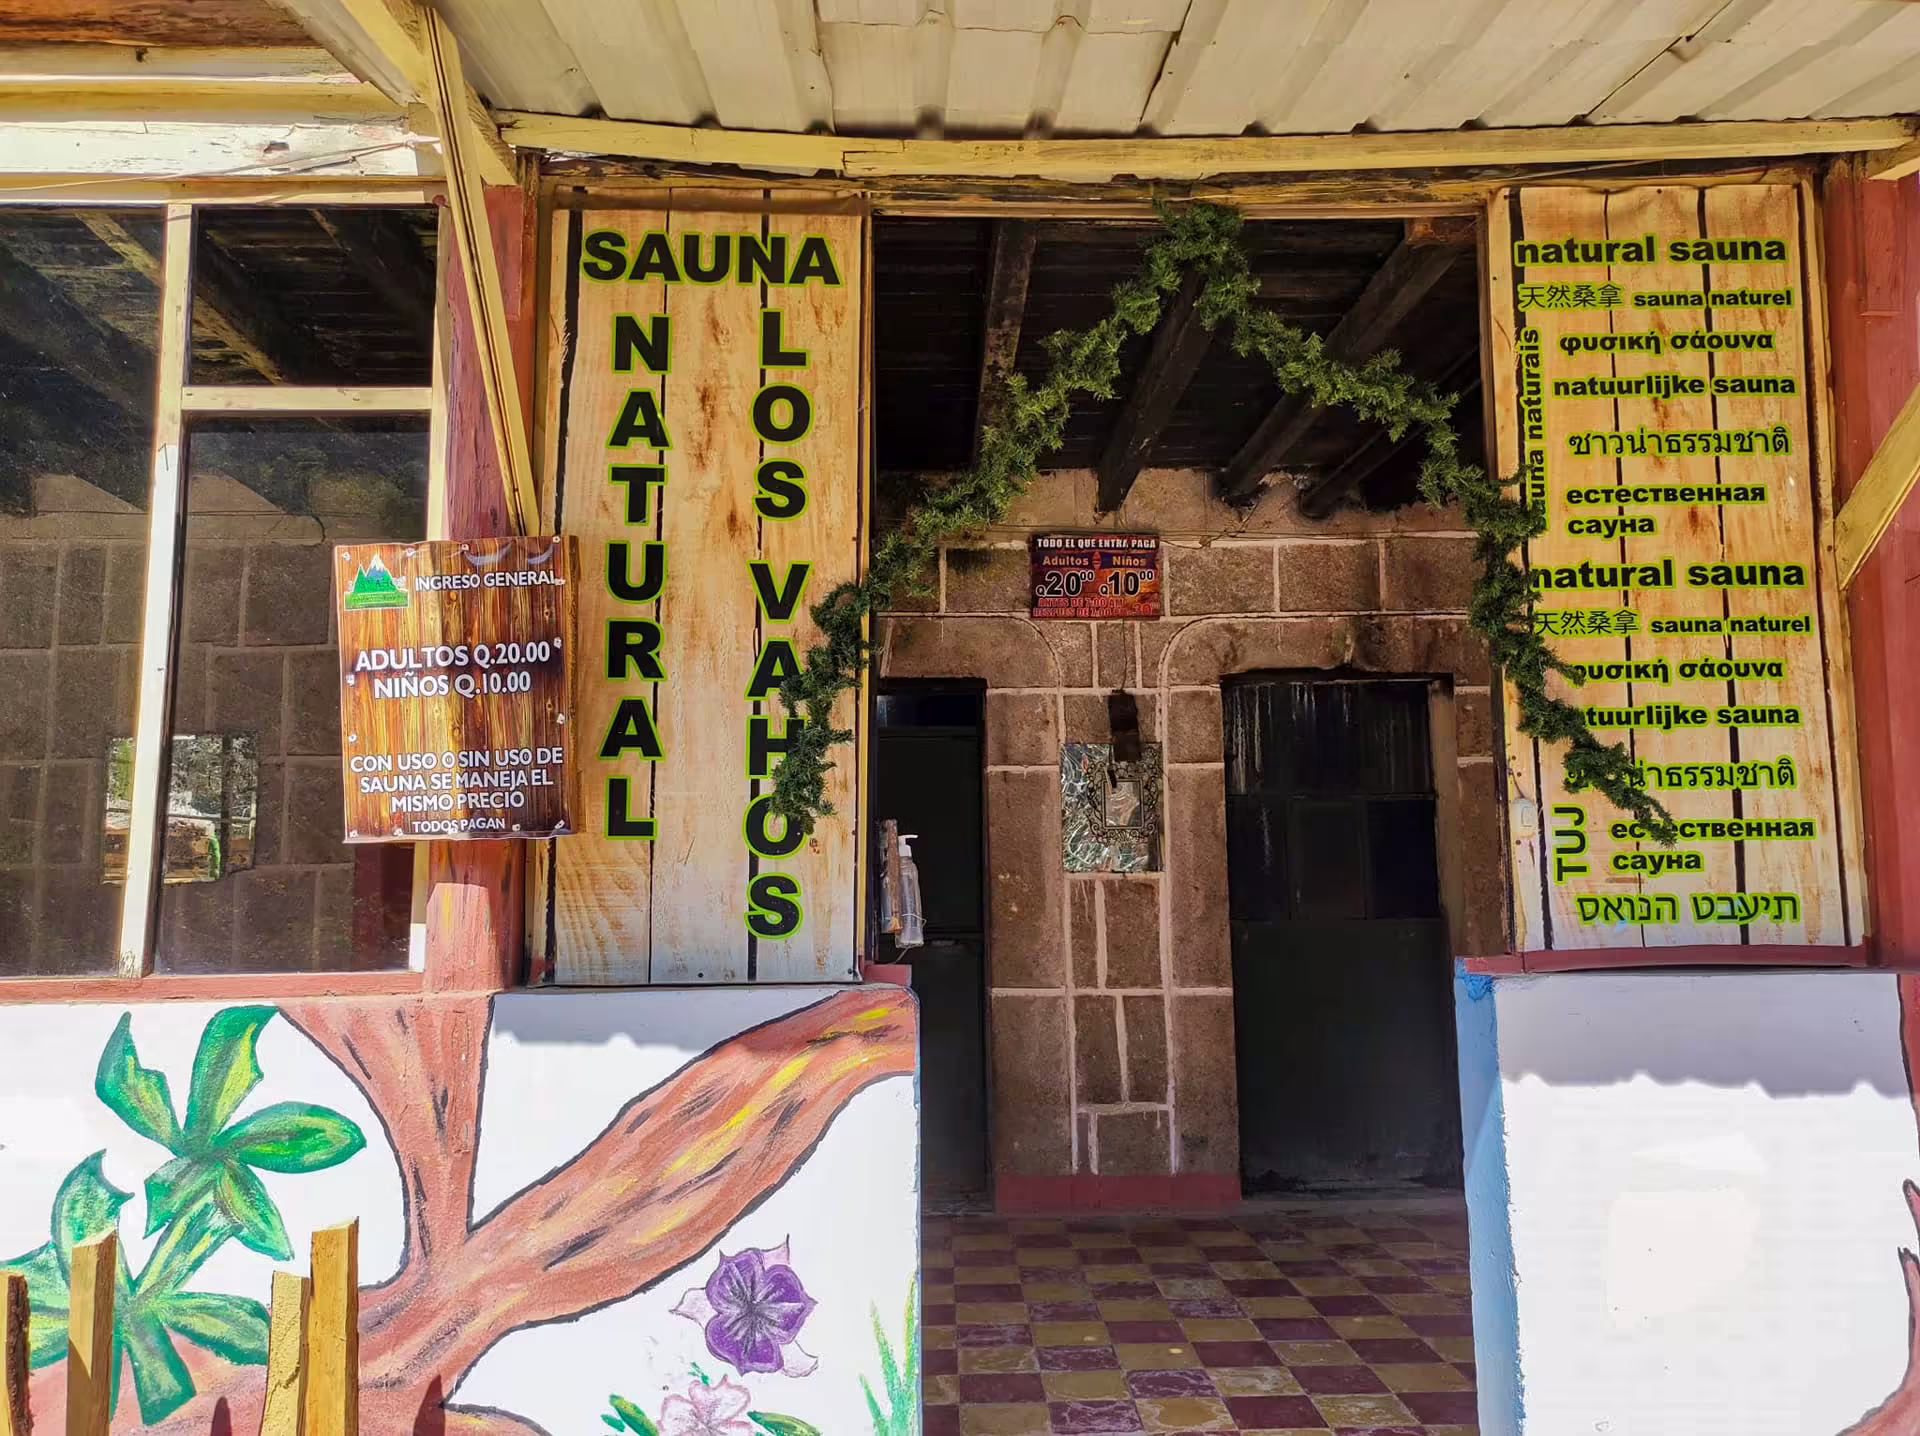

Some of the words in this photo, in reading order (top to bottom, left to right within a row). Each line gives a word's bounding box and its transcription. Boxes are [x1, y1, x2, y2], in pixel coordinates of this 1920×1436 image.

[585, 231, 839, 285] SAUNA
[1516, 236, 1655, 264] natural
[1669, 238, 1787, 262] sauna
[1521, 285, 1623, 308] 天然桑拿
[1634, 292, 1704, 307] sauna
[1711, 290, 1792, 306] naturel
[1560, 332, 1661, 355] φυσική
[1670, 332, 1773, 350] σάουνα
[1520, 329, 1544, 440] naturais
[1554, 375, 1705, 398] natuurlijke
[1712, 377, 1796, 393] sauna
[753, 311, 809, 519] LOS
[1568, 426, 1789, 456] ซาวน่าธรรมชาติ
[1566, 486, 1765, 504] естественная
[1567, 517, 1655, 539] сауна
[1037, 538, 1063, 548] TODO
[1065, 538, 1075, 548] EL
[1077, 538, 1096, 549] QUE
[1099, 538, 1129, 548] ENTRA
[1042, 555, 1089, 566] Adultos
[1112, 555, 1146, 566] Niños
[415, 573, 480, 592] INGRESO
[484, 571, 558, 588] GENERAL
[602, 315, 669, 838] NATURAL
[1532, 559, 1673, 588] natural
[1688, 563, 1805, 587] sauna
[1534, 610, 1639, 635] 天然桑拿
[1651, 618, 1722, 633] sauna
[1730, 616, 1811, 632] naturel
[355, 645, 469, 672] ADULTOS
[473, 641, 550, 668] Q.20.00
[1679, 659, 1784, 678] σάουνα
[374, 671, 449, 698] NIÑOS
[454, 671, 532, 698] Q.10.00
[1580, 705, 1708, 730] tuurlijke
[1717, 706, 1800, 724] sauna
[350, 755, 392, 773] CON
[398, 753, 437, 770] USO
[441, 752, 456, 769] O
[458, 750, 490, 767] SIN
[495, 748, 532, 766] USO
[536, 747, 563, 764] DE
[745, 562, 811, 937] VAHOS
[360, 774, 430, 793] SAUNA
[430, 773, 452, 791] SE
[455, 770, 528, 790] MANEJA
[531, 769, 553, 786] EL
[391, 794, 454, 813] MISMO
[457, 791, 525, 809] PRECIO
[412, 820, 459, 833] TODOS
[460, 817, 505, 831] PAGAN
[1611, 821, 1814, 839] есственная
[1554, 807, 1588, 882] TUJ
[1612, 853, 1701, 875] сауна
